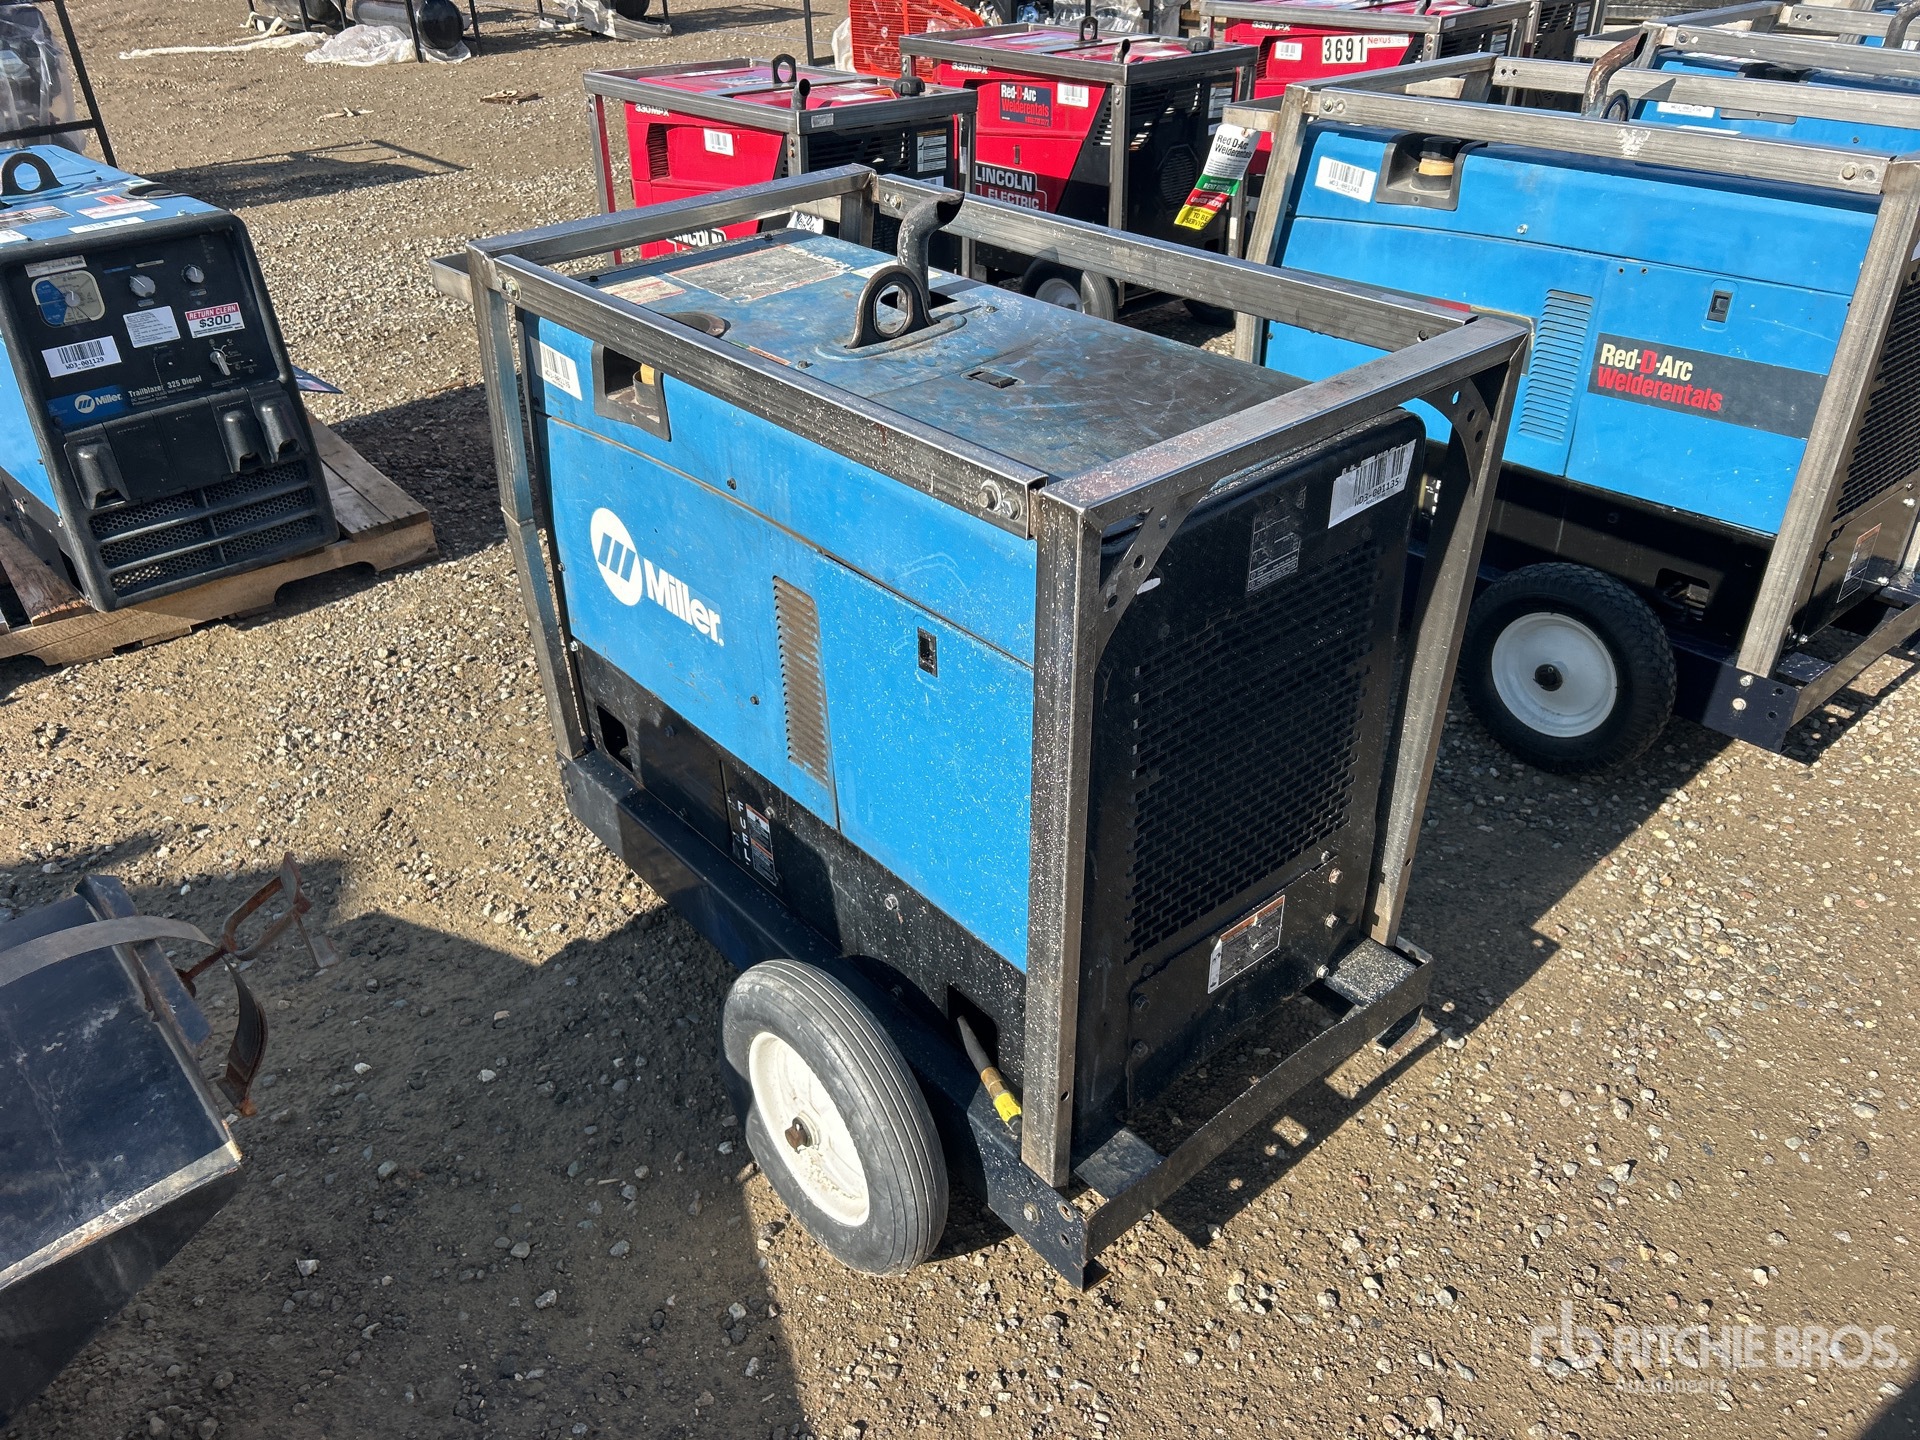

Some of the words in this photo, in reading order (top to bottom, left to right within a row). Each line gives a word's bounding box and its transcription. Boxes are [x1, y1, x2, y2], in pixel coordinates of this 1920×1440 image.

[1324, 36, 1366, 62] 3691
[1001, 84, 1037, 102] Red-D-Arc
[1001, 99, 1050, 118] Welderentals
[975, 165, 1032, 192] LINCOLN
[988, 188, 1039, 210] ELECTRIC
[189, 309, 214, 320] RETURN
[215, 305, 236, 315] CLEAN
[199, 314, 231, 329] $300
[65, 356, 105, 370] WD3-001129
[1600, 343, 1693, 382] Red-D-Arc
[166, 380, 181, 389] 325
[180, 374, 203, 386] Diesel
[1597, 366, 1723, 412] Welderentals
[94, 392, 122, 407] Miller
[1354, 477, 1400, 507] WD3-001135
[643, 558, 721, 644] Miller
